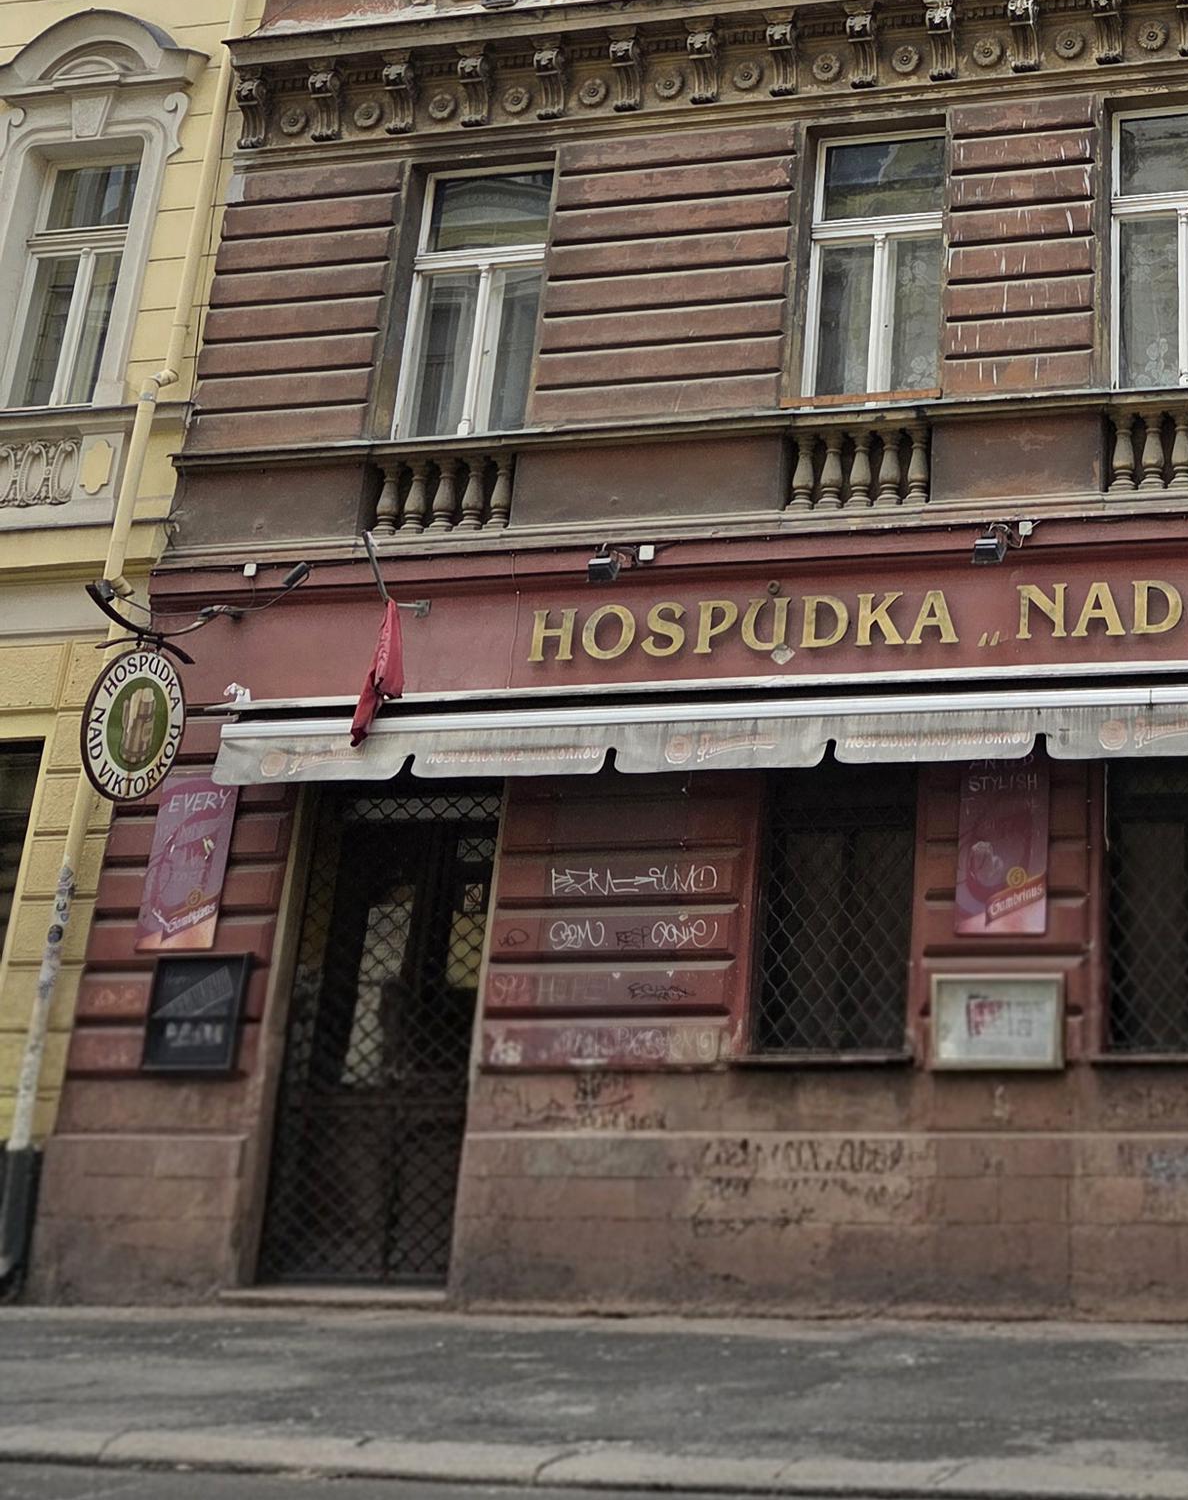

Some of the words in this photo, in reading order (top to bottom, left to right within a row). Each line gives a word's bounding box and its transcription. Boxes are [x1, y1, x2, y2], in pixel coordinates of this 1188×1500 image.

[527, 580, 960, 662] HOSPŮDKA
[103, 654, 181, 713] HOSPŮDKA
[88, 707, 107, 760] NAD
[98, 724, 182, 797] VIKTORKOU
[168, 789, 232, 814] EVERY
[989, 883, 1044, 916] Gambrinus
